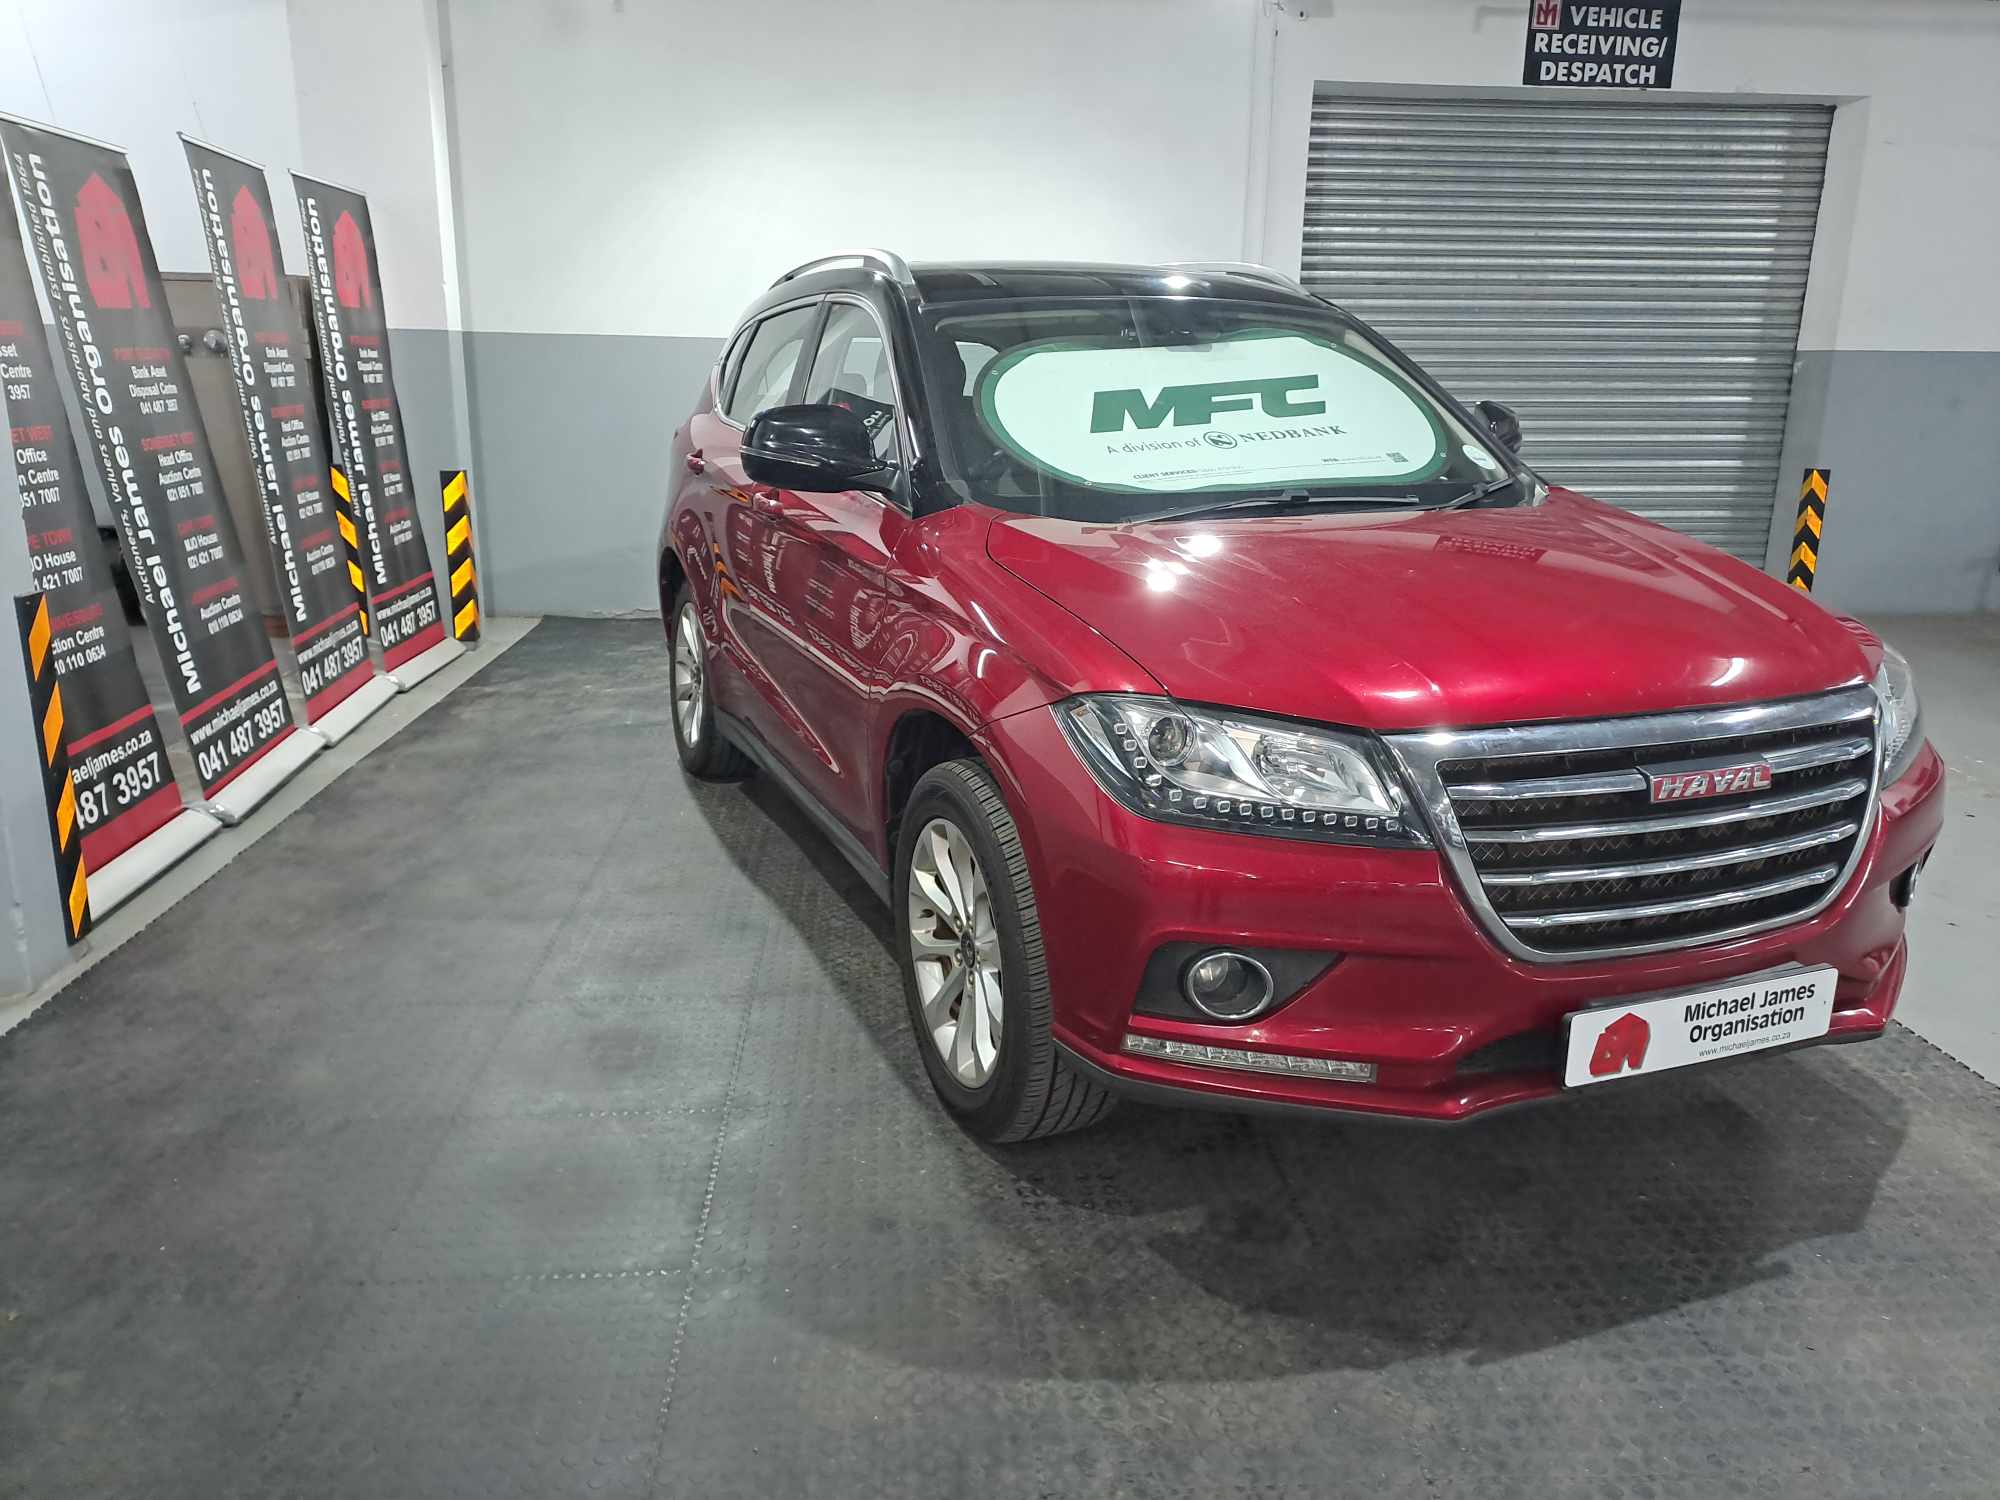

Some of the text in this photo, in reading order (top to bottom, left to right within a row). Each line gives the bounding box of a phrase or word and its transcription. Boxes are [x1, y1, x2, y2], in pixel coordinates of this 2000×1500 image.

[1570, 6, 1664, 30] VEHICLE
[1534, 33, 1668, 58] RECEIVING/
[1540, 61, 1657, 85] DESPATCH
[25, 200, 62, 301] Established
[28, 153, 113, 415] Organisation
[202, 168, 256, 386] Organisation
[0, 363, 32, 379] Centre
[60, 315, 93, 404] Appraisers
[7, 384, 31, 400] 3957
[307, 197, 387, 585] Michael James Organisation
[1090, 374, 1326, 433] MFC
[86, 406, 103, 440] and
[1106, 425, 1349, 455] A division of NEDBANK
[16, 447, 48, 465] Office
[250, 396, 280, 497] James
[27, 467, 60, 485] Centre
[98, 444, 122, 502] Valuers
[108, 426, 155, 545] James
[38, 486, 61, 503] 7007
[42, 572, 62, 590] 421
[62, 566, 84, 586] 7007
[44, 549, 77, 569] House
[272, 505, 307, 623] Michael
[76, 625, 105, 646] Centre
[146, 555, 202, 694] Michael
[380, 600, 436, 647] 041 487 3957
[85, 643, 107, 664] 0634
[301, 635, 365, 696] 041 487 3957
[198, 697, 286, 781] 041 487 3957
[112, 751, 160, 805] 3957
[1658, 766, 1772, 799] HAVAL
[1684, 983, 1816, 1023] Michael James
[1689, 1005, 1805, 1043] Organisation
